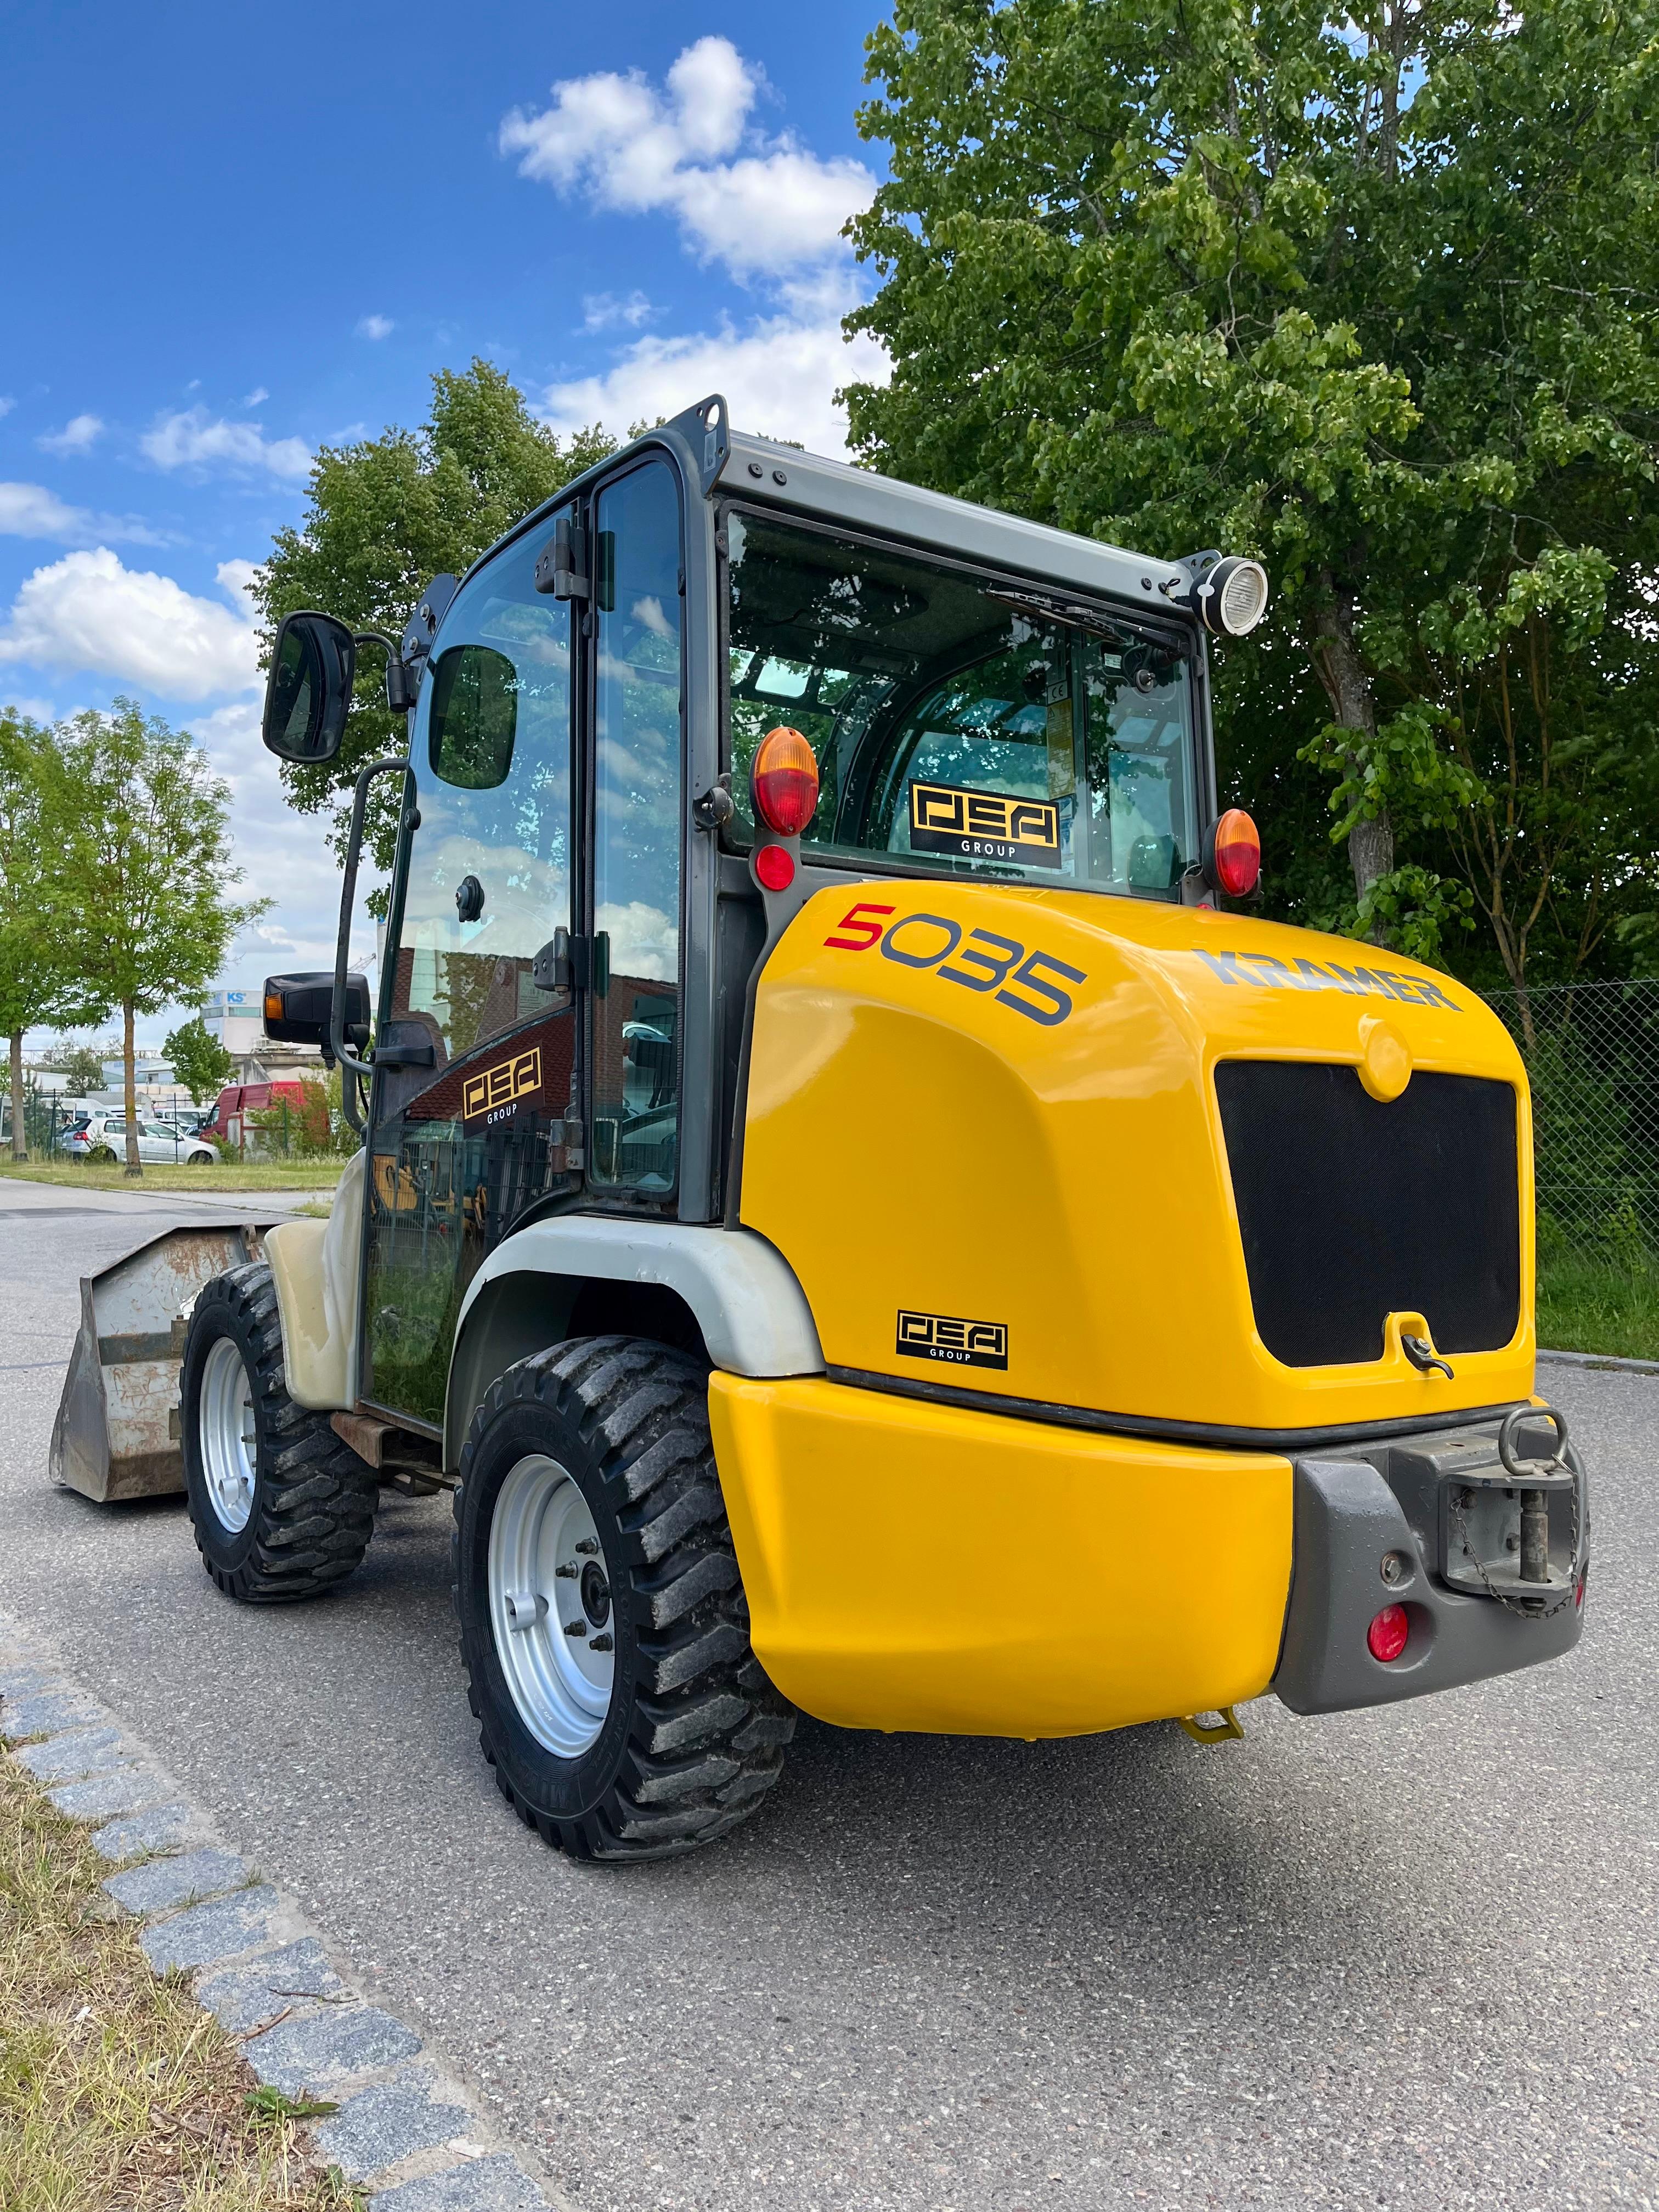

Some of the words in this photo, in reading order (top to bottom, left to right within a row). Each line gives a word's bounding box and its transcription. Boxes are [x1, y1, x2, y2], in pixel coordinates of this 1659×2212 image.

[1052, 684, 1064, 699] CE
[961, 840, 1015, 857] GROUP
[822, 903, 1088, 1026] 5035
[1189, 949, 1465, 1013] KRAMER
[227, 992, 245, 1003] KS
[487, 1103, 517, 1125] GROUP
[930, 1348, 970, 1361] GROUP
